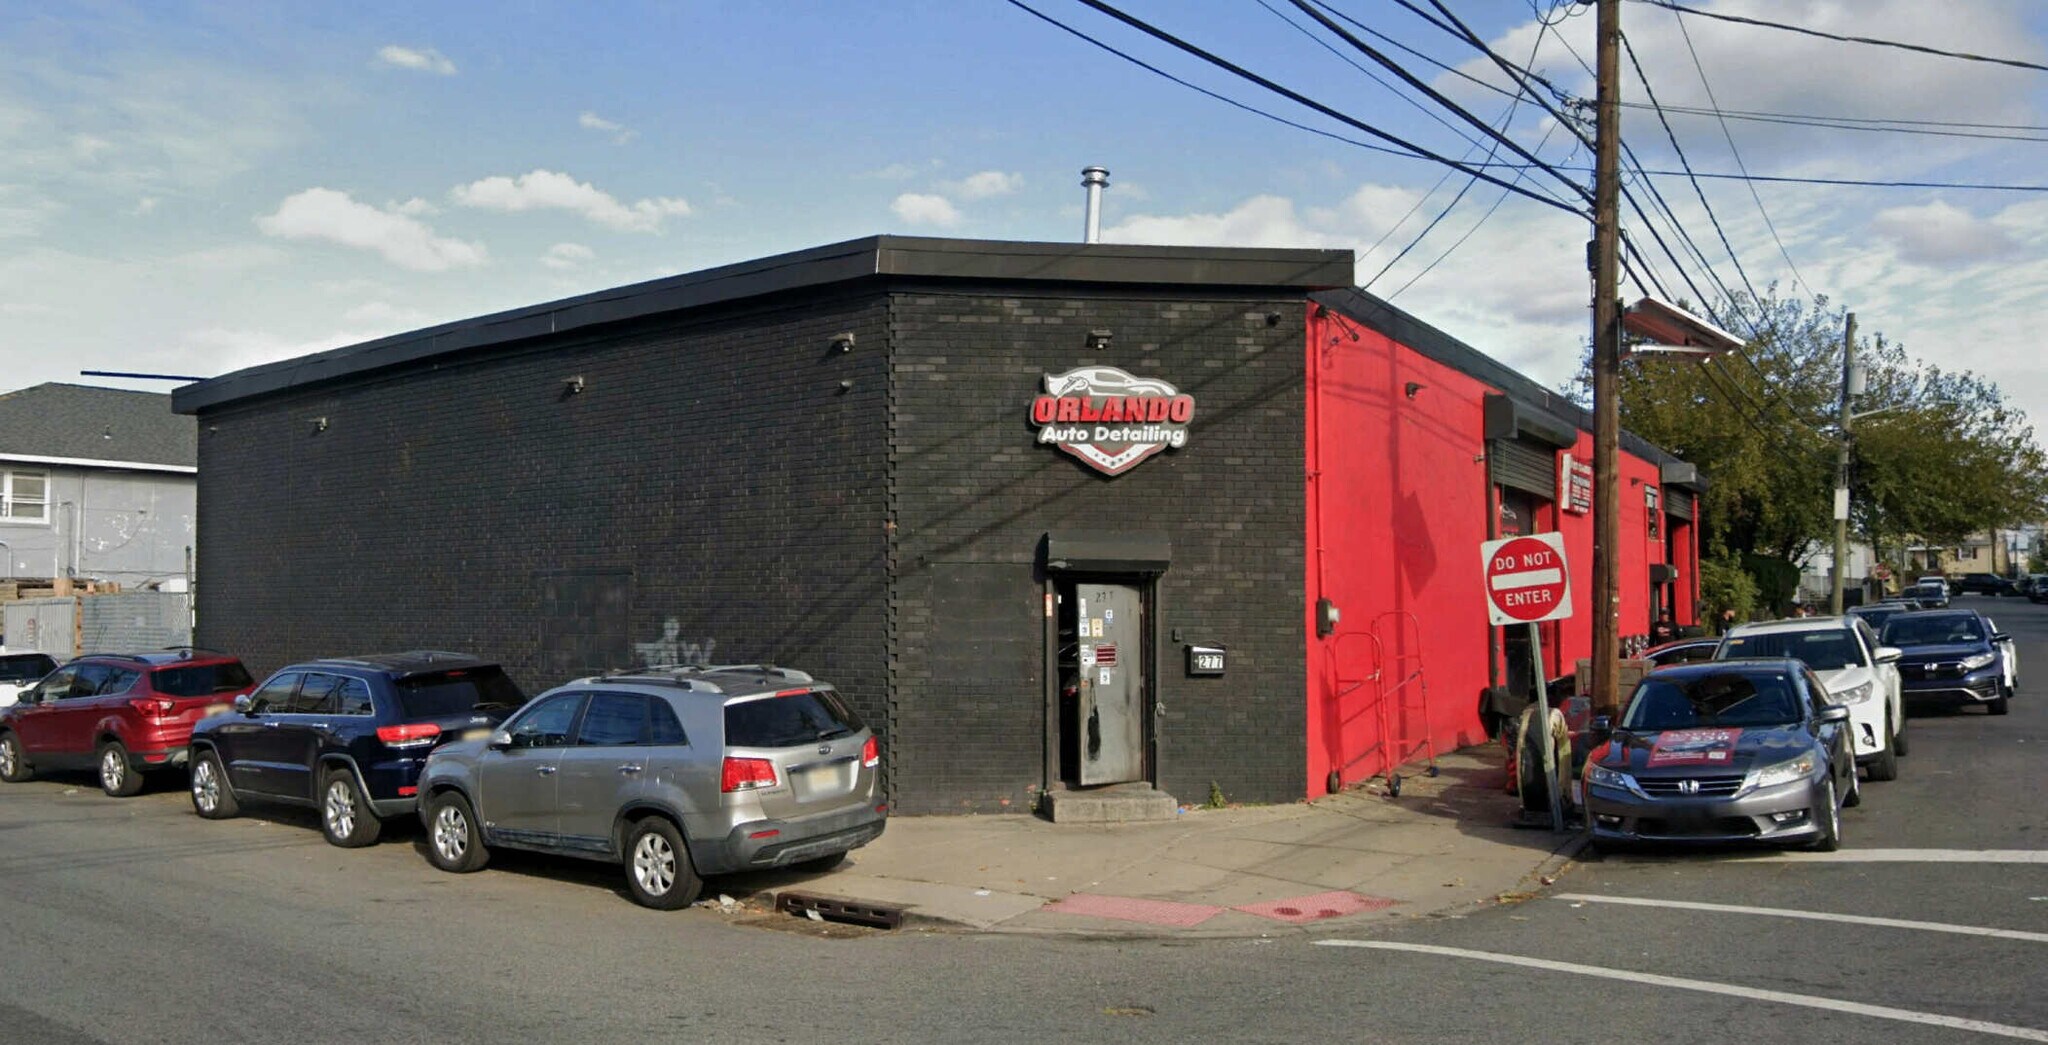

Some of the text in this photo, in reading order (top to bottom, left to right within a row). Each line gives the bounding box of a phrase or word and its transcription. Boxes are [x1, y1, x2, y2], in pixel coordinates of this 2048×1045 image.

[1033, 395, 1193, 423] ORLANDO
[1041, 425, 1186, 447] Auto Detailing
[1495, 551, 1552, 571] DO NOT
[1505, 589, 1552, 607] ENTER
[1200, 655, 1222, 669] 277
